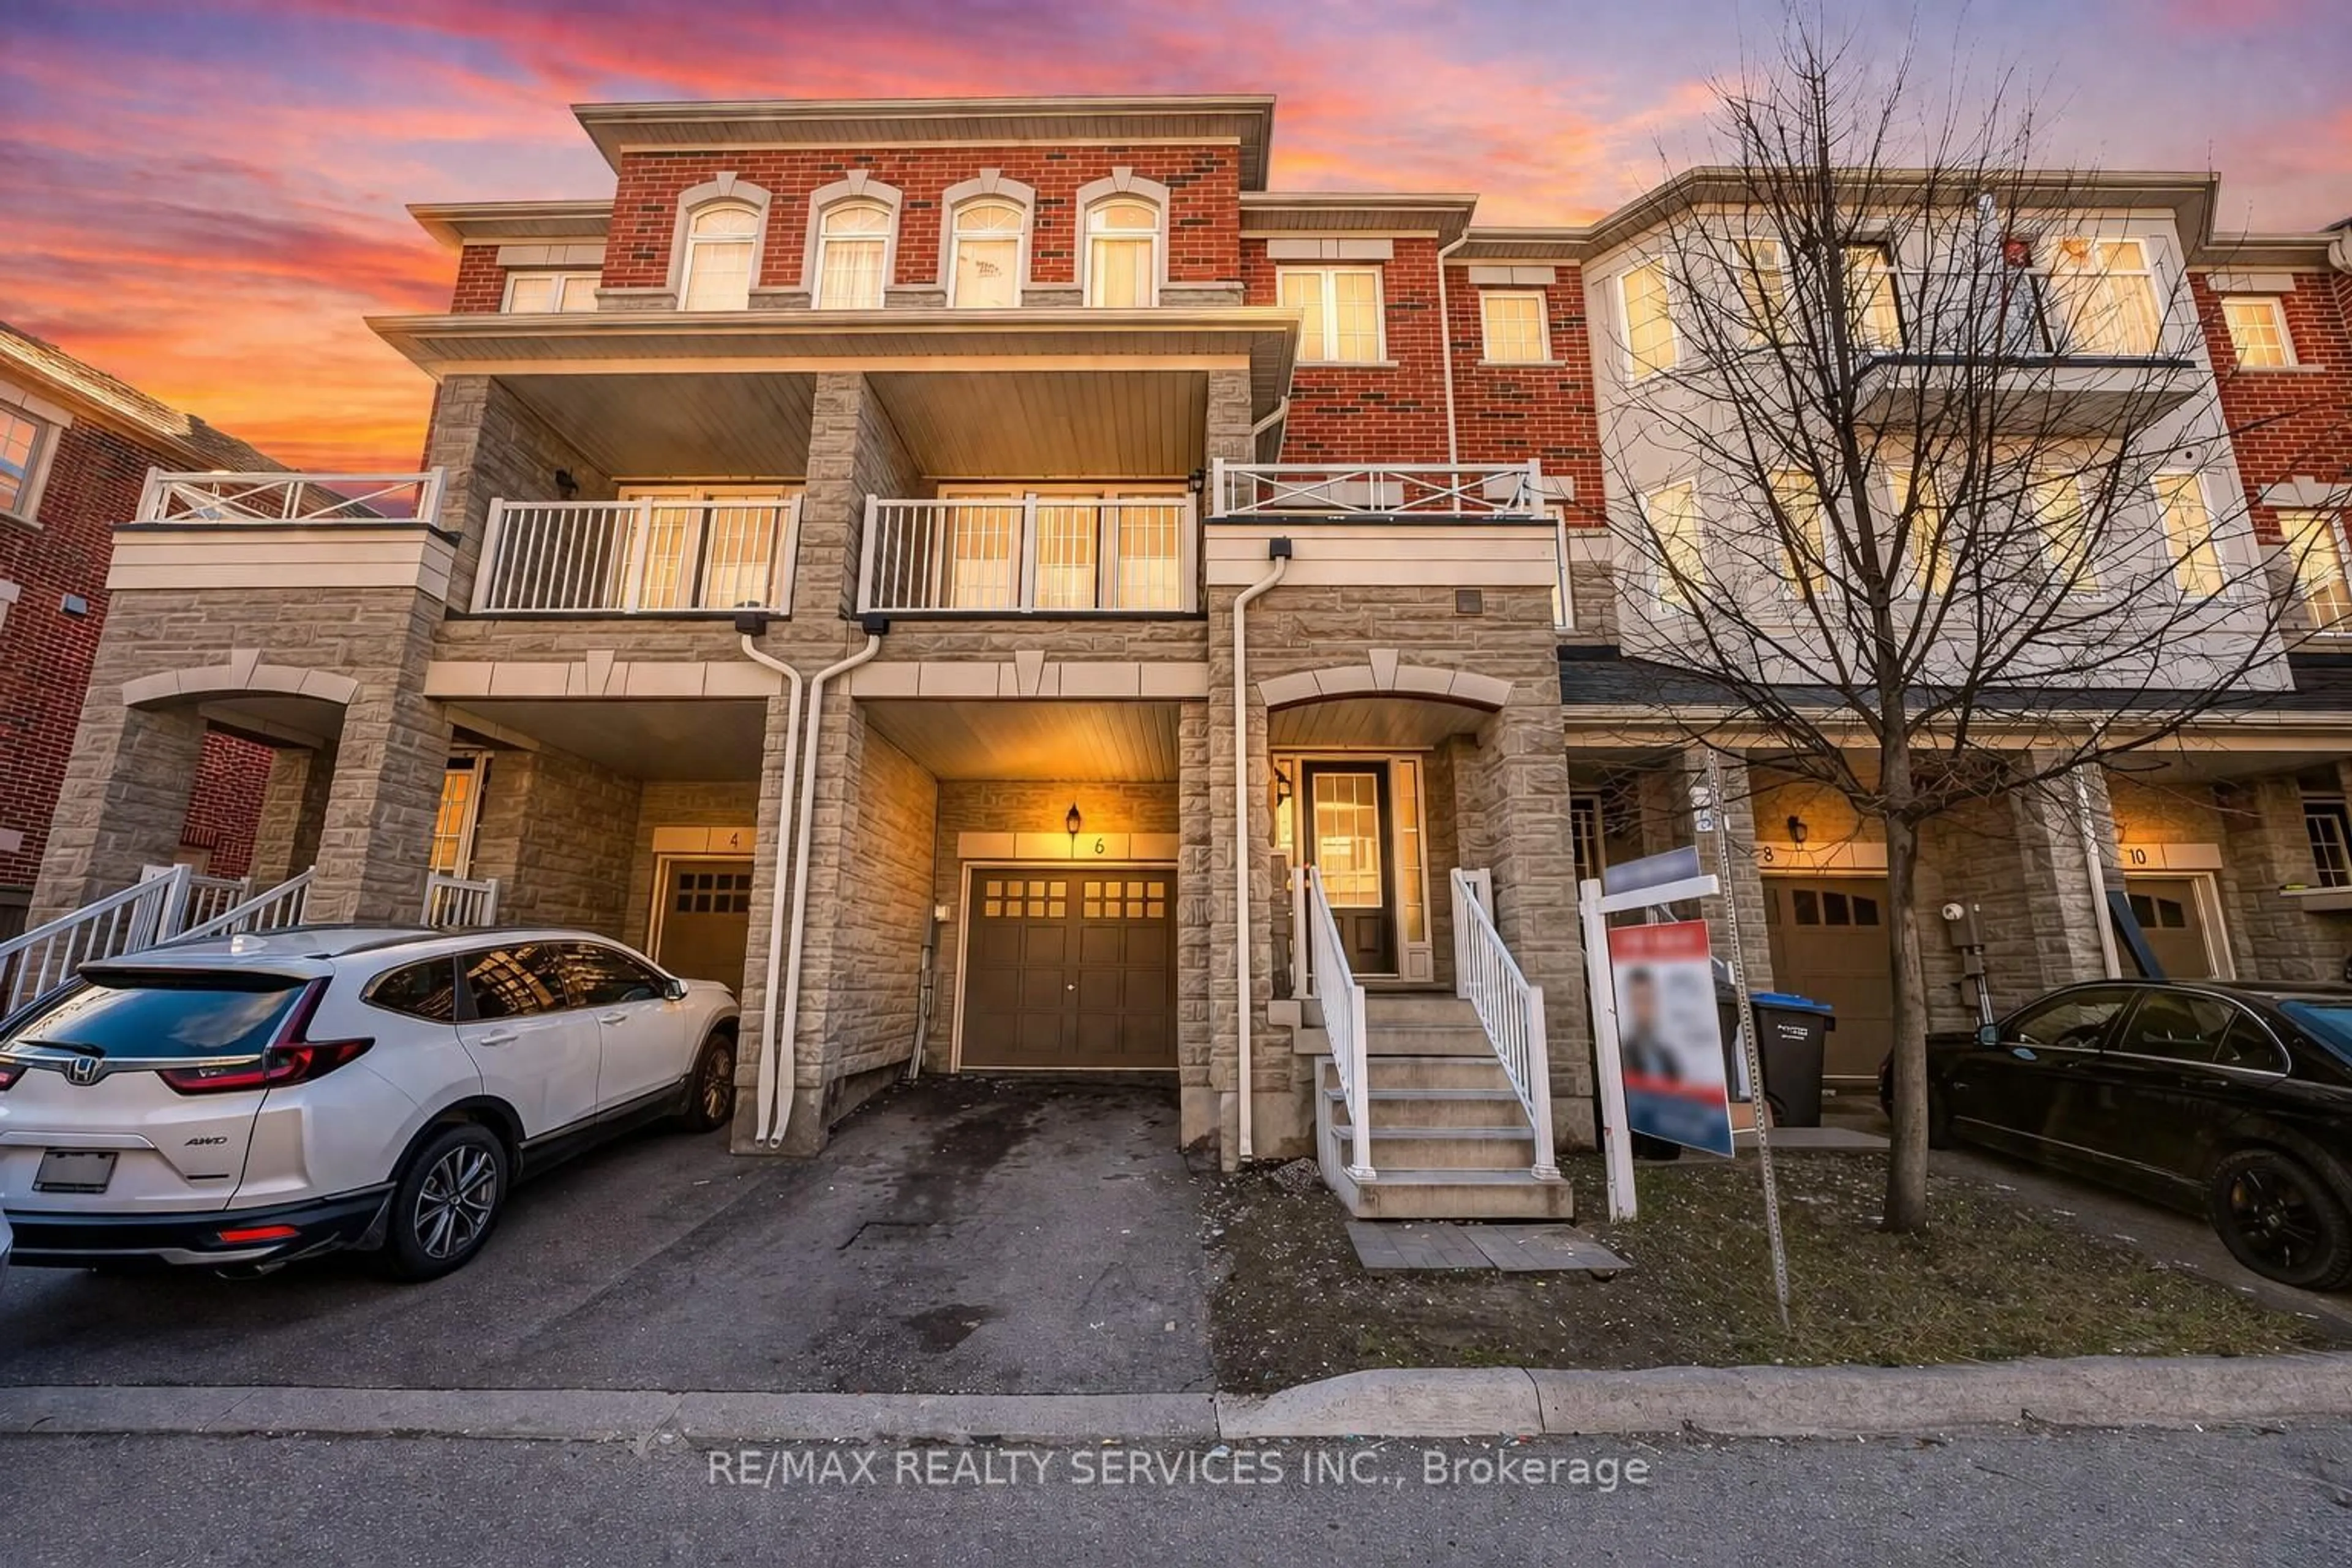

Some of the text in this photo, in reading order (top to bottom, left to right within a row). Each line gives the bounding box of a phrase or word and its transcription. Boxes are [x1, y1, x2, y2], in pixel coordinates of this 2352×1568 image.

[729, 832, 737, 849] 4
[1095, 837, 1105, 854] 6
[1764, 846, 1774, 862] 8
[2129, 848, 2146, 865] 10
[184, 1136, 228, 1146] AWD
